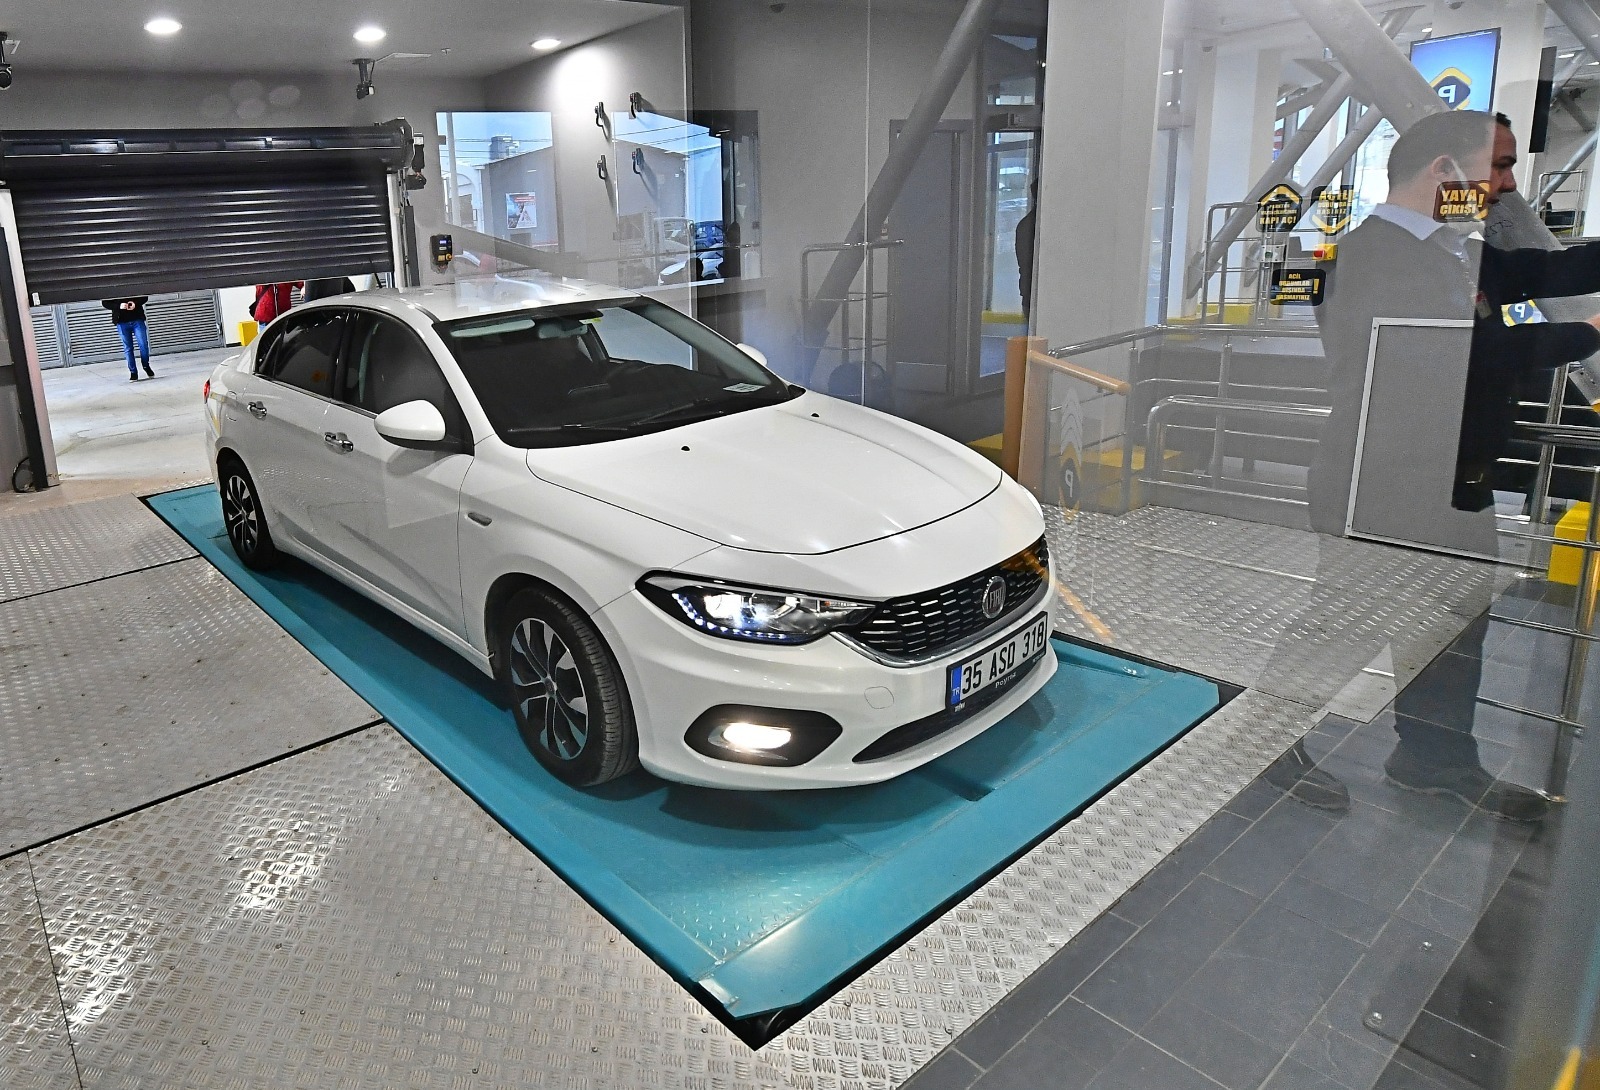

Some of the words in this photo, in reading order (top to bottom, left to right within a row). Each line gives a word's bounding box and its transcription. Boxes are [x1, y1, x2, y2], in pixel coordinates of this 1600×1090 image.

[1441, 189, 1477, 202] YAYA
[1439, 204, 1476, 217] ÇIKIŞI
[1259, 216, 1280, 225] KAPI
[1281, 216, 1297, 225] AÇ!
[962, 660, 983, 694] 35
[989, 640, 1016, 681] ASD
[1022, 621, 1045, 659] 318
